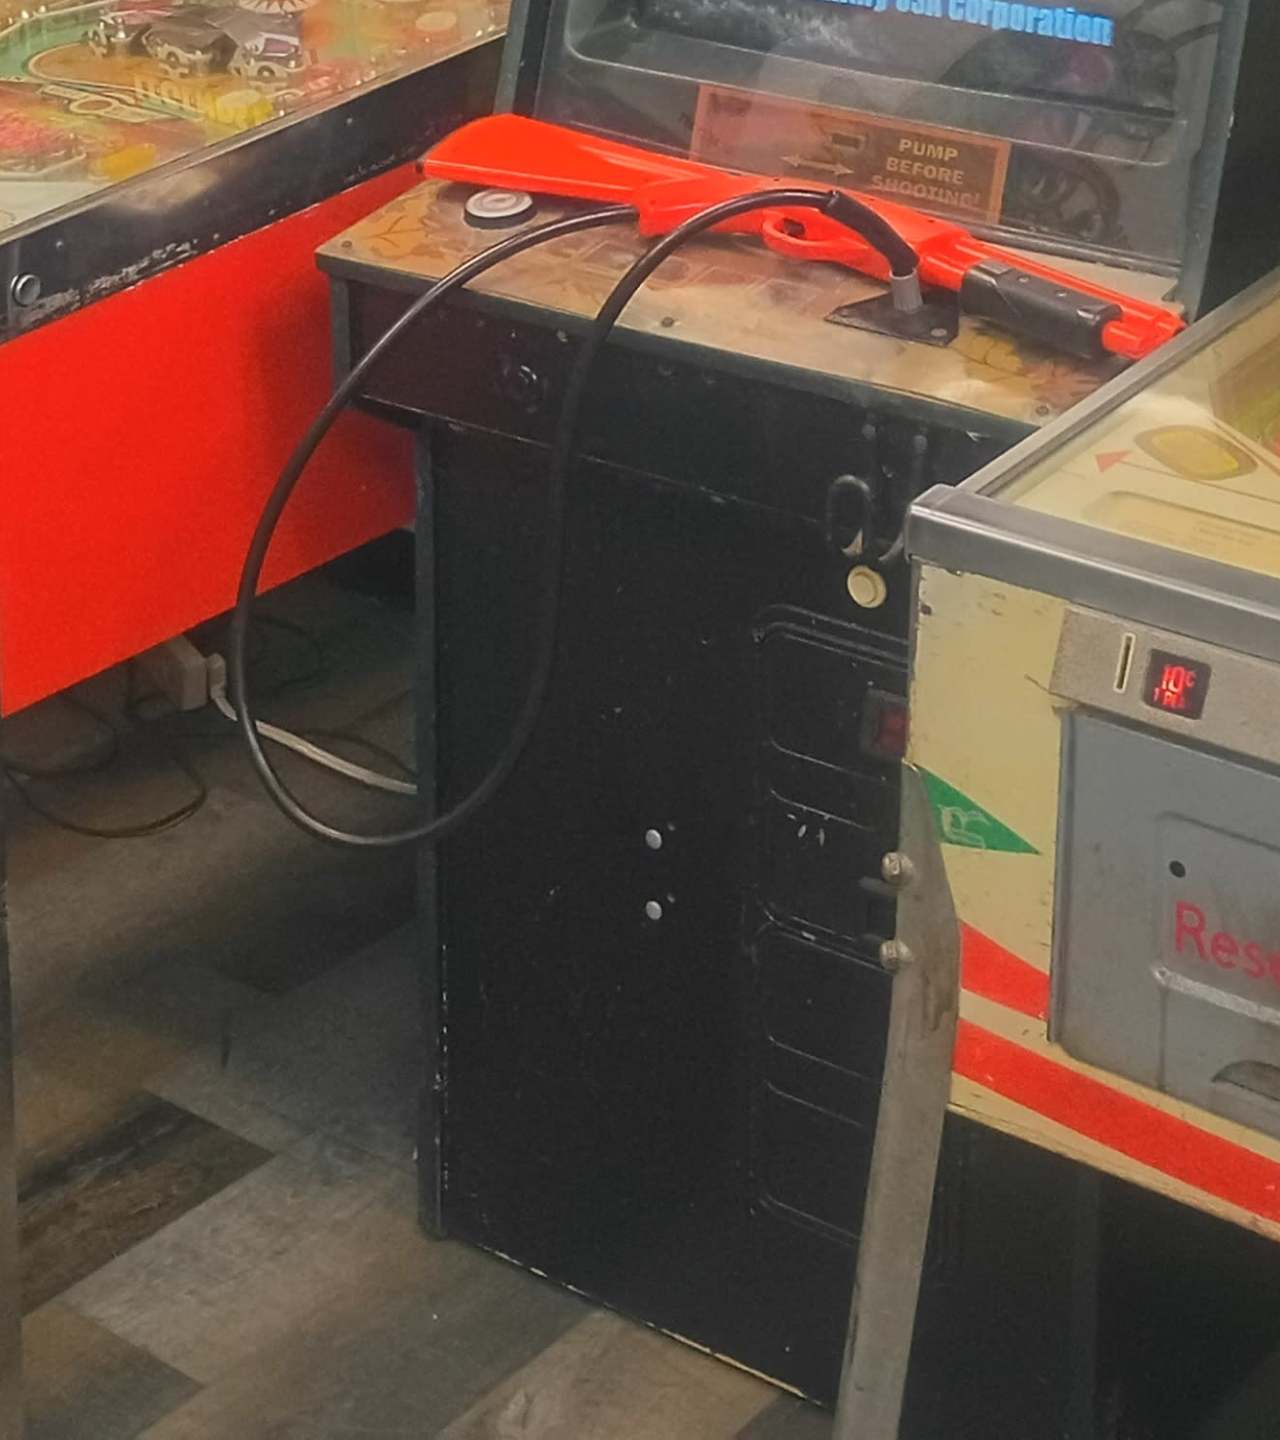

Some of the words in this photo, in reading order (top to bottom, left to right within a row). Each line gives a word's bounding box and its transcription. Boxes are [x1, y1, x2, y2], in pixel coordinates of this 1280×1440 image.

[898, 139, 959, 162] PUMP
[885, 157, 966, 186] BEFORE
[870, 176, 982, 211] SHOOTING!
[1163, 690, 1186, 710] PL
